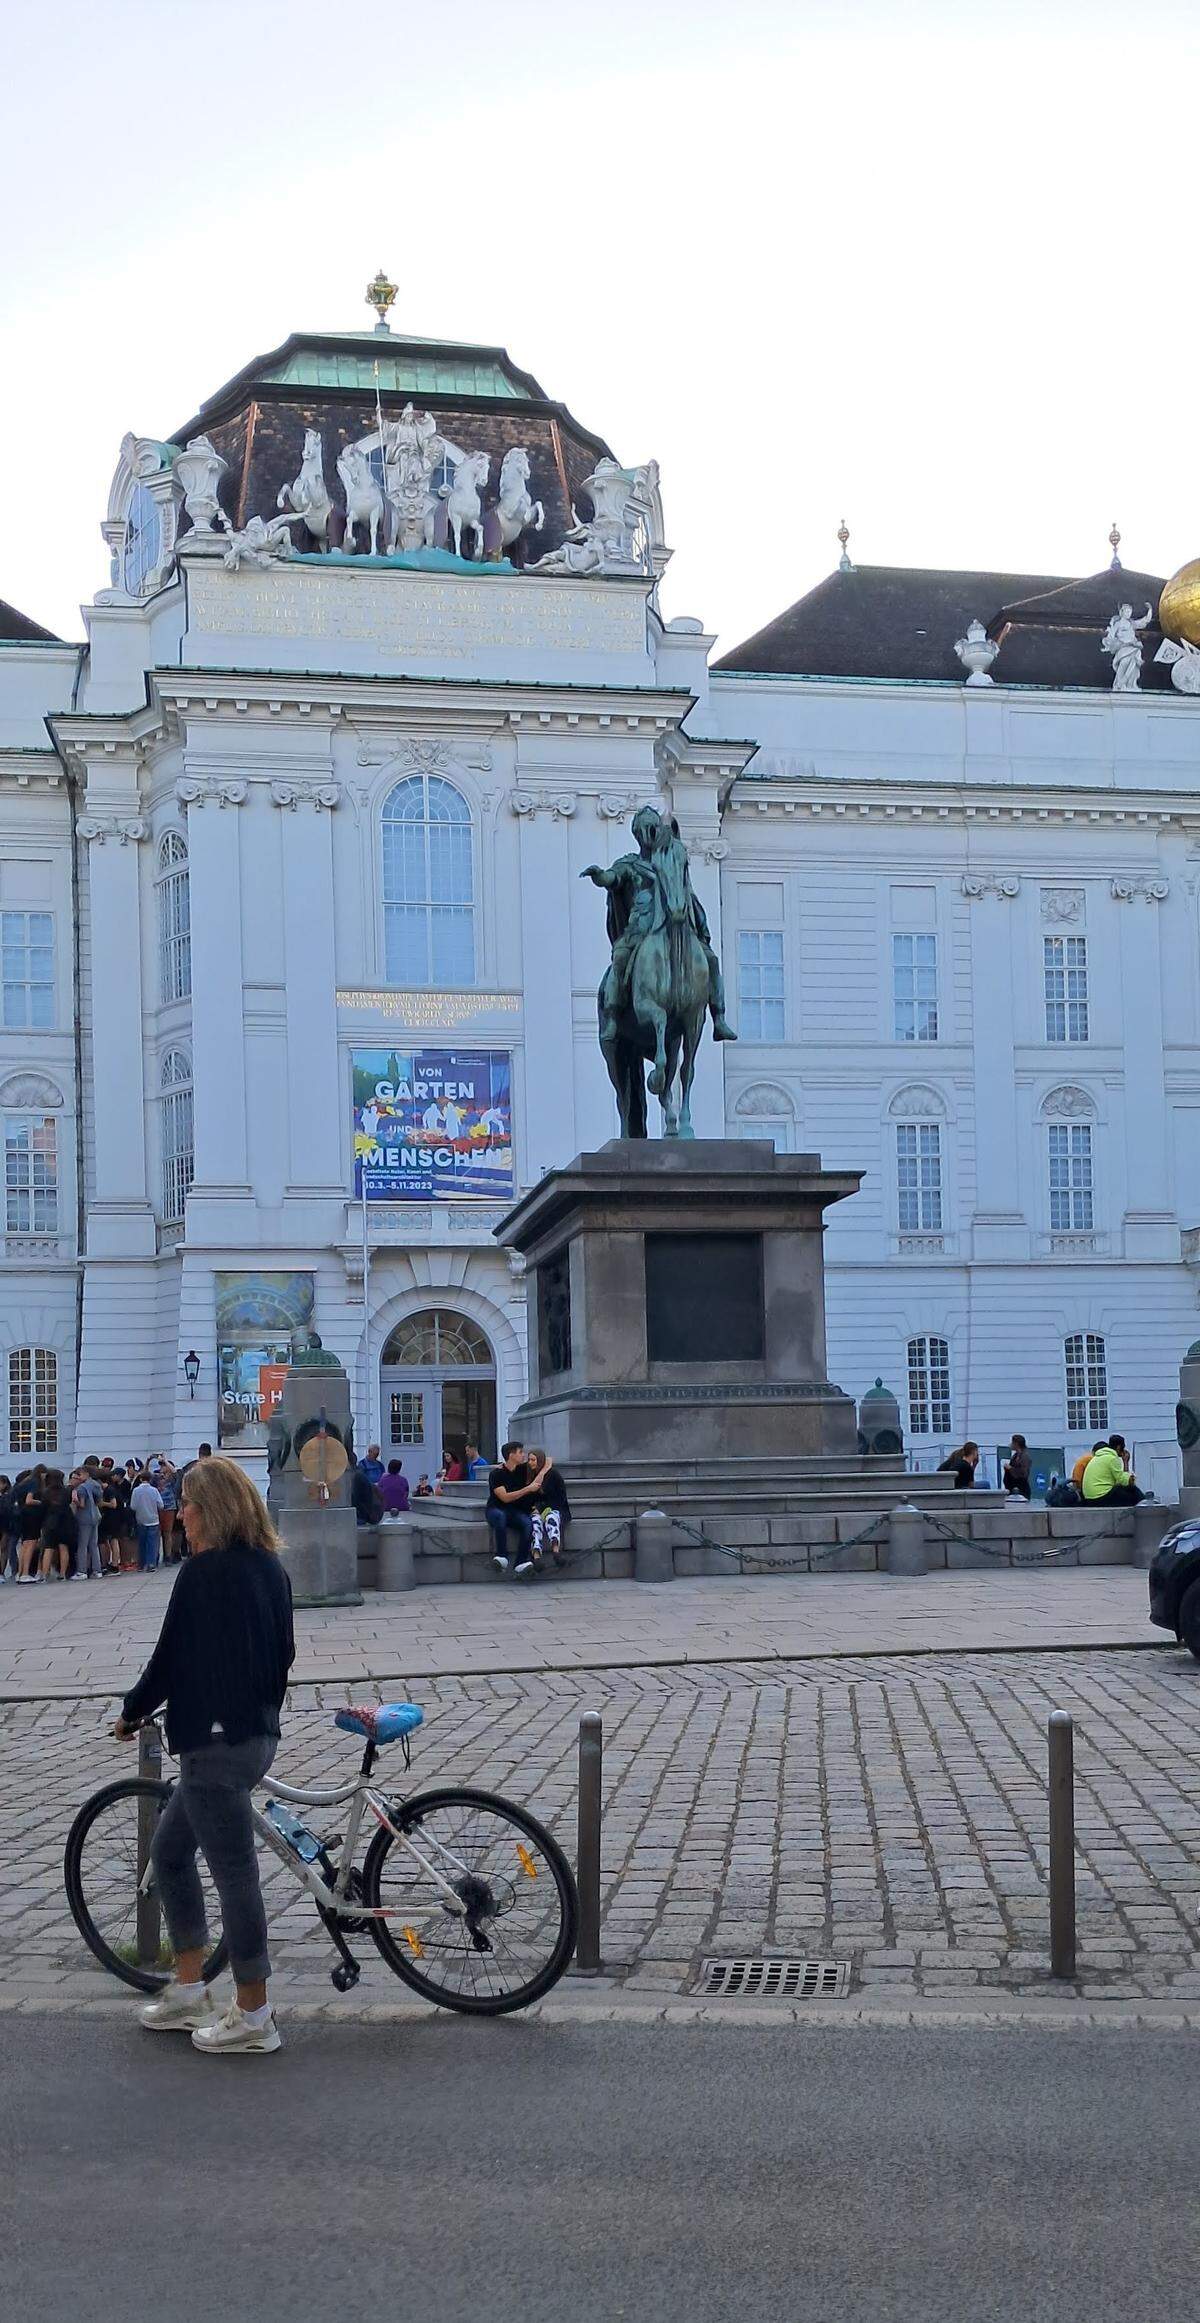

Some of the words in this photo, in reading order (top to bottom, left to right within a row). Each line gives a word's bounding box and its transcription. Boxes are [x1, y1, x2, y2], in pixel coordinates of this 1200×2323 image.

[418, 1068, 442, 1077] VON
[375, 1077, 475, 1100] GÄRTEN
[389, 1125, 413, 1134] UND
[362, 1147, 503, 1167] MENSCHEN
[224, 1390, 266, 1404] State
[270, 1390, 283, 1404] H
